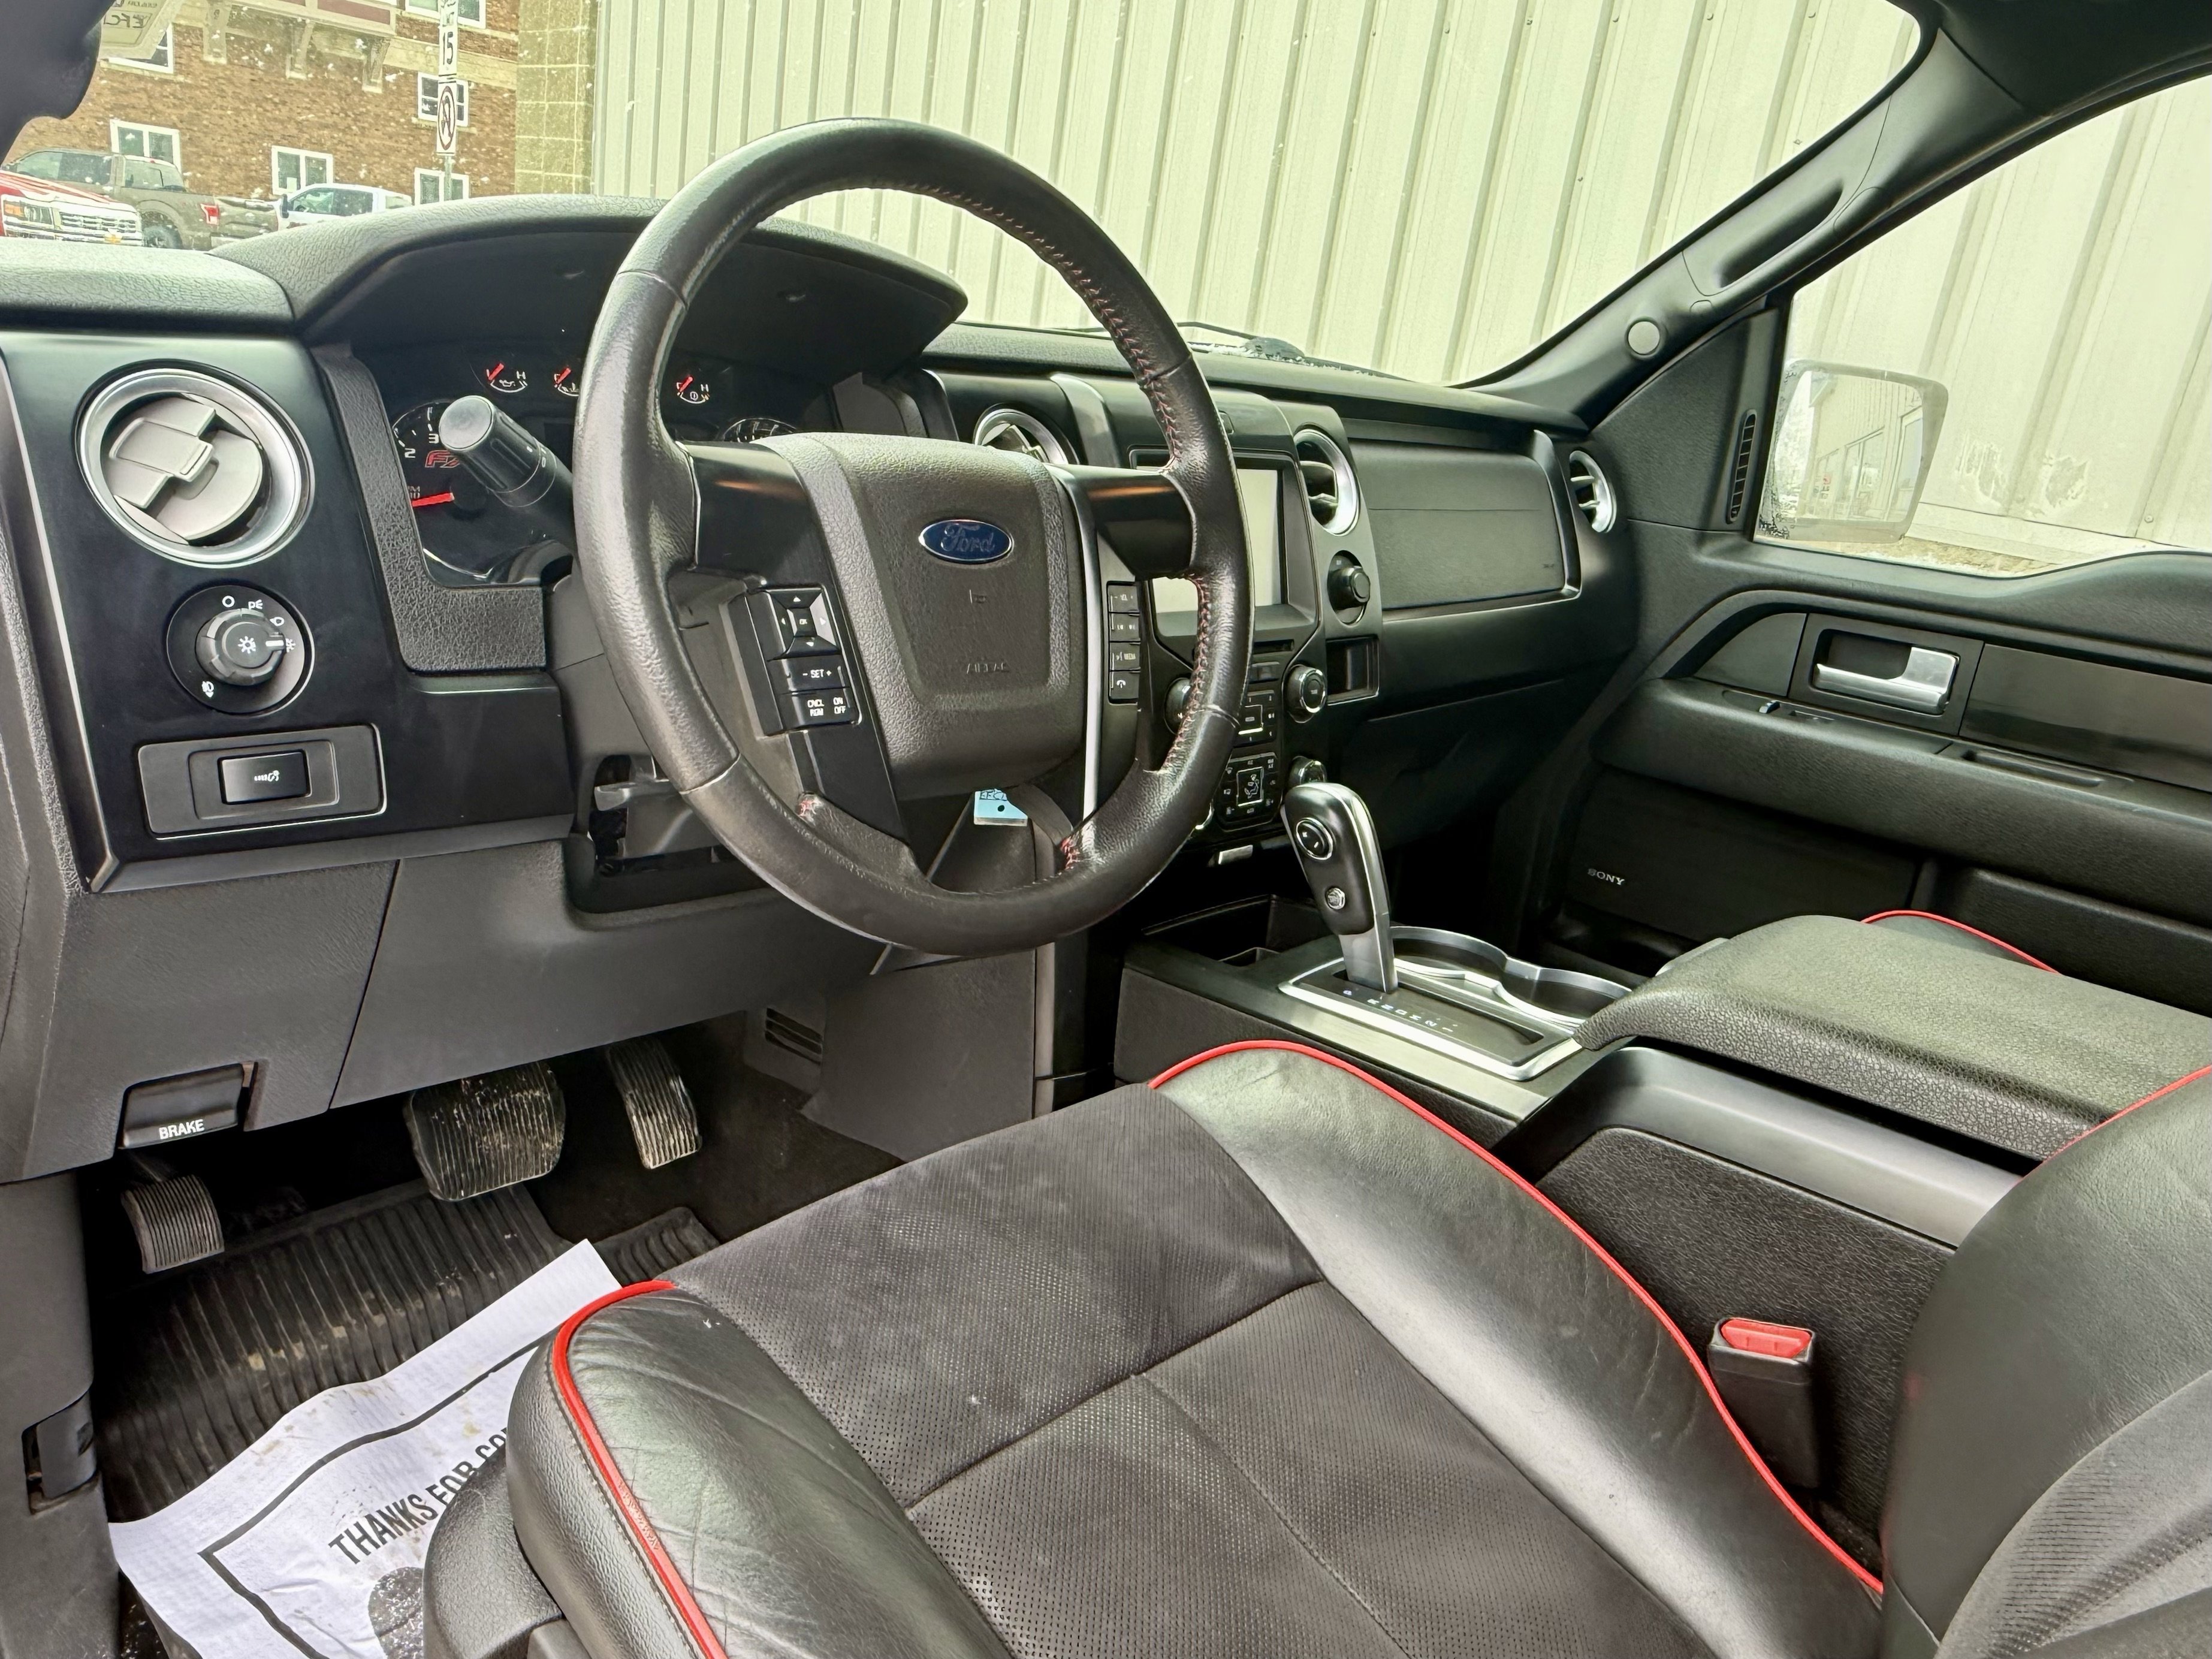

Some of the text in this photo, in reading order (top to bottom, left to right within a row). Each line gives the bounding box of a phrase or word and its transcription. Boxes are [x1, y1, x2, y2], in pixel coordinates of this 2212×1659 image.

[442, 31, 453, 65] 15
[428, 433, 439, 444] 3
[404, 448, 416, 458] 2
[940, 523, 995, 553] Ford
[810, 669, 825, 678] SET
[833, 697, 844, 705] ON
[834, 705, 846, 714] OFF
[1587, 868, 1625, 885] SONY
[158, 1118, 206, 1140] BRAKE
[328, 1494, 439, 1564] THANKS
[425, 1461, 478, 1506] FOR
